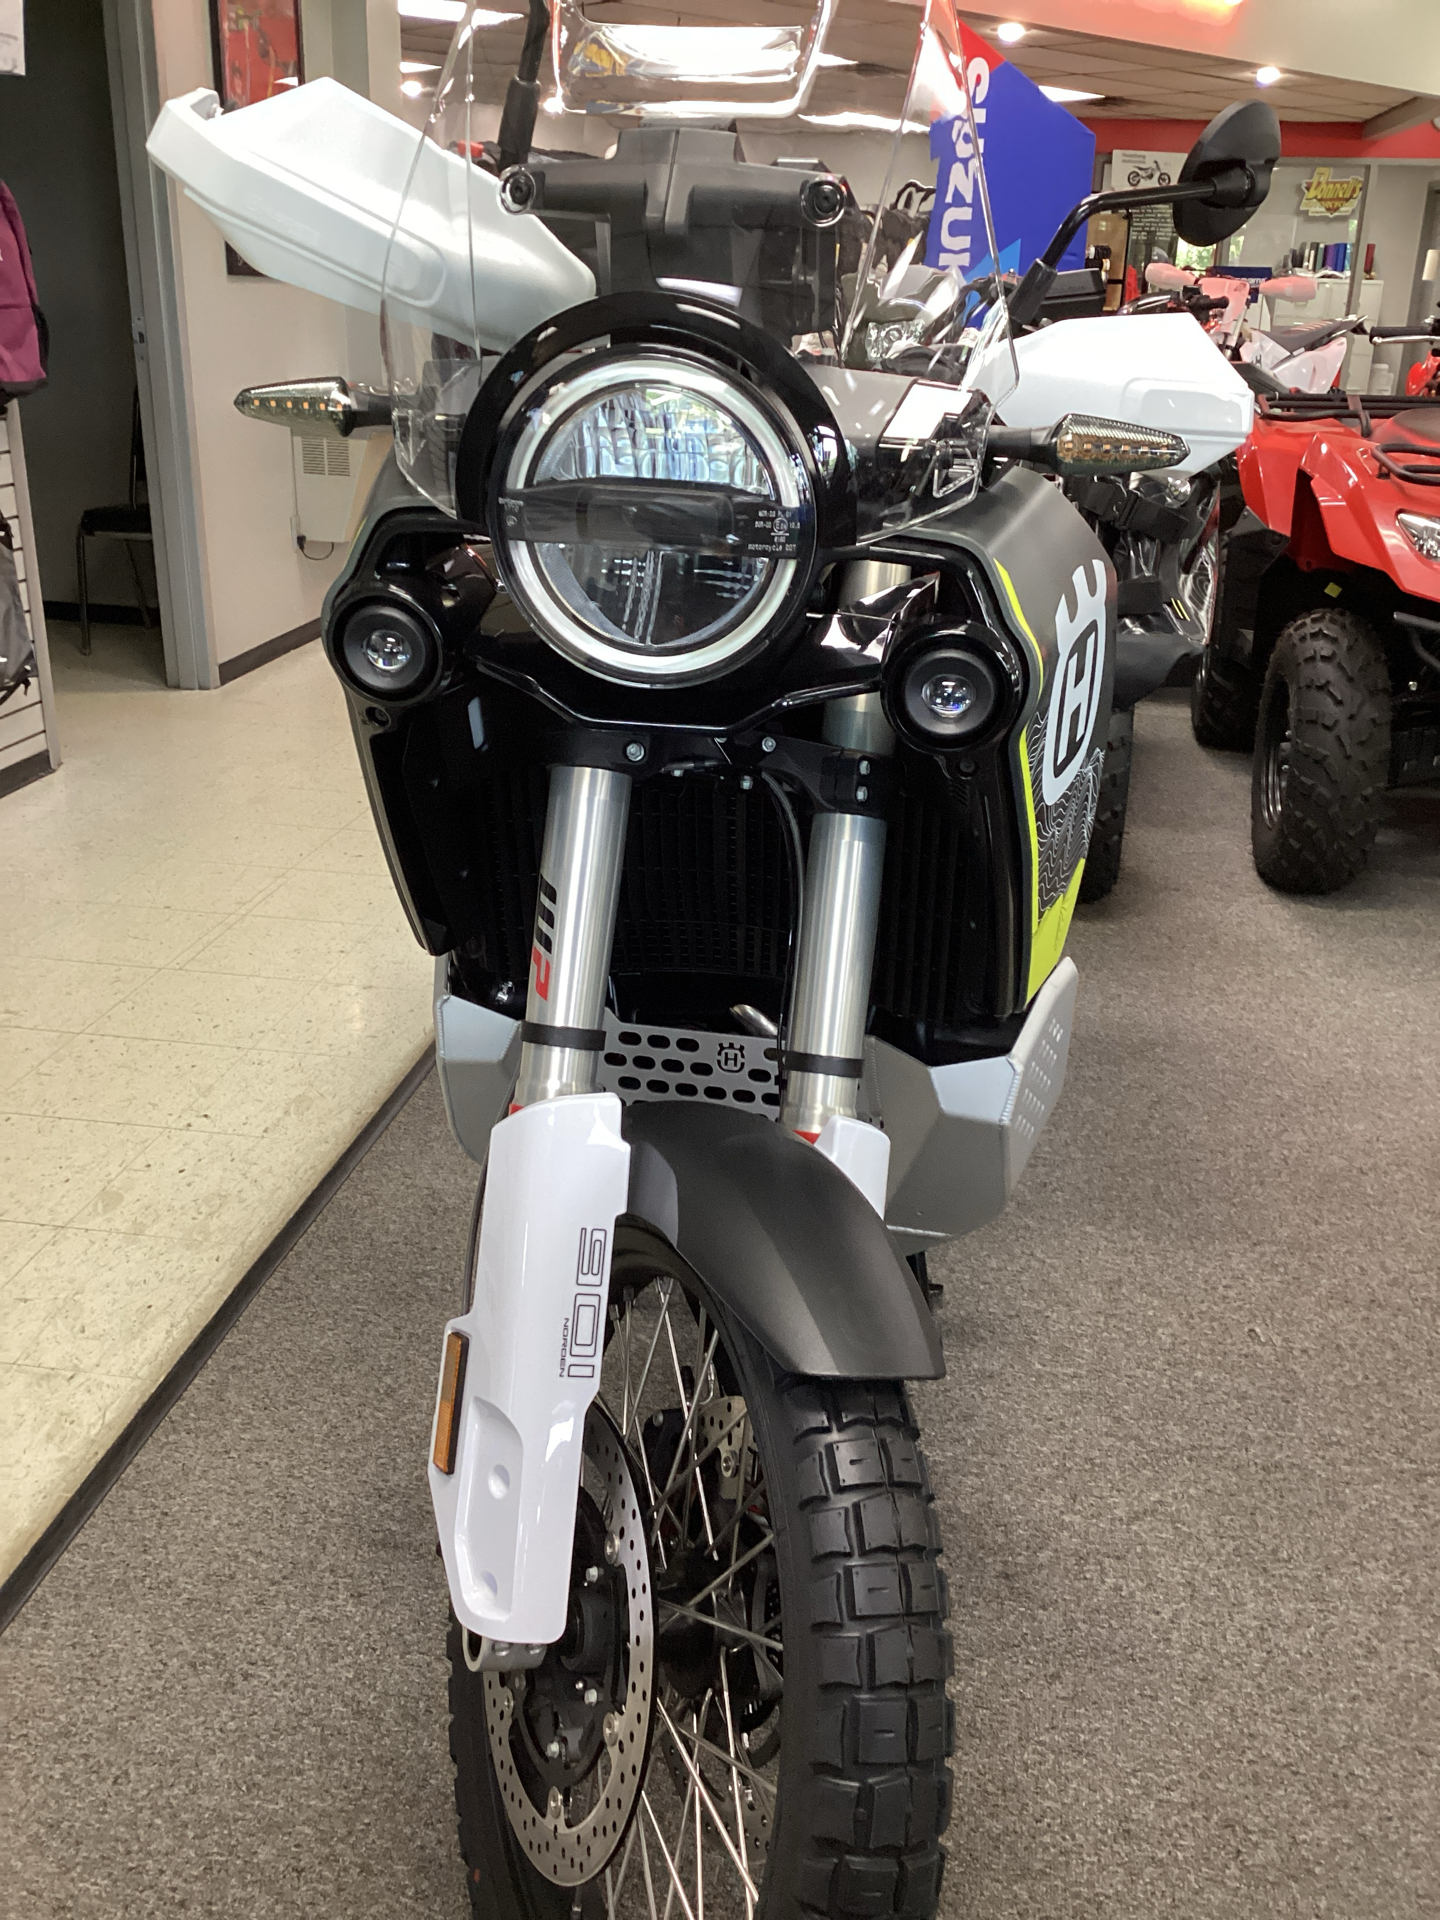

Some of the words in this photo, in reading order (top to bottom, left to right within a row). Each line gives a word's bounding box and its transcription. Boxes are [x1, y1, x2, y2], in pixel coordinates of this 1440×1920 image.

[1306, 166, 1363, 200] Donnell's
[785, 543, 797, 551] DOT
[567, 1228, 607, 1378] 901
[559, 1317, 570, 1378] NORDEN
